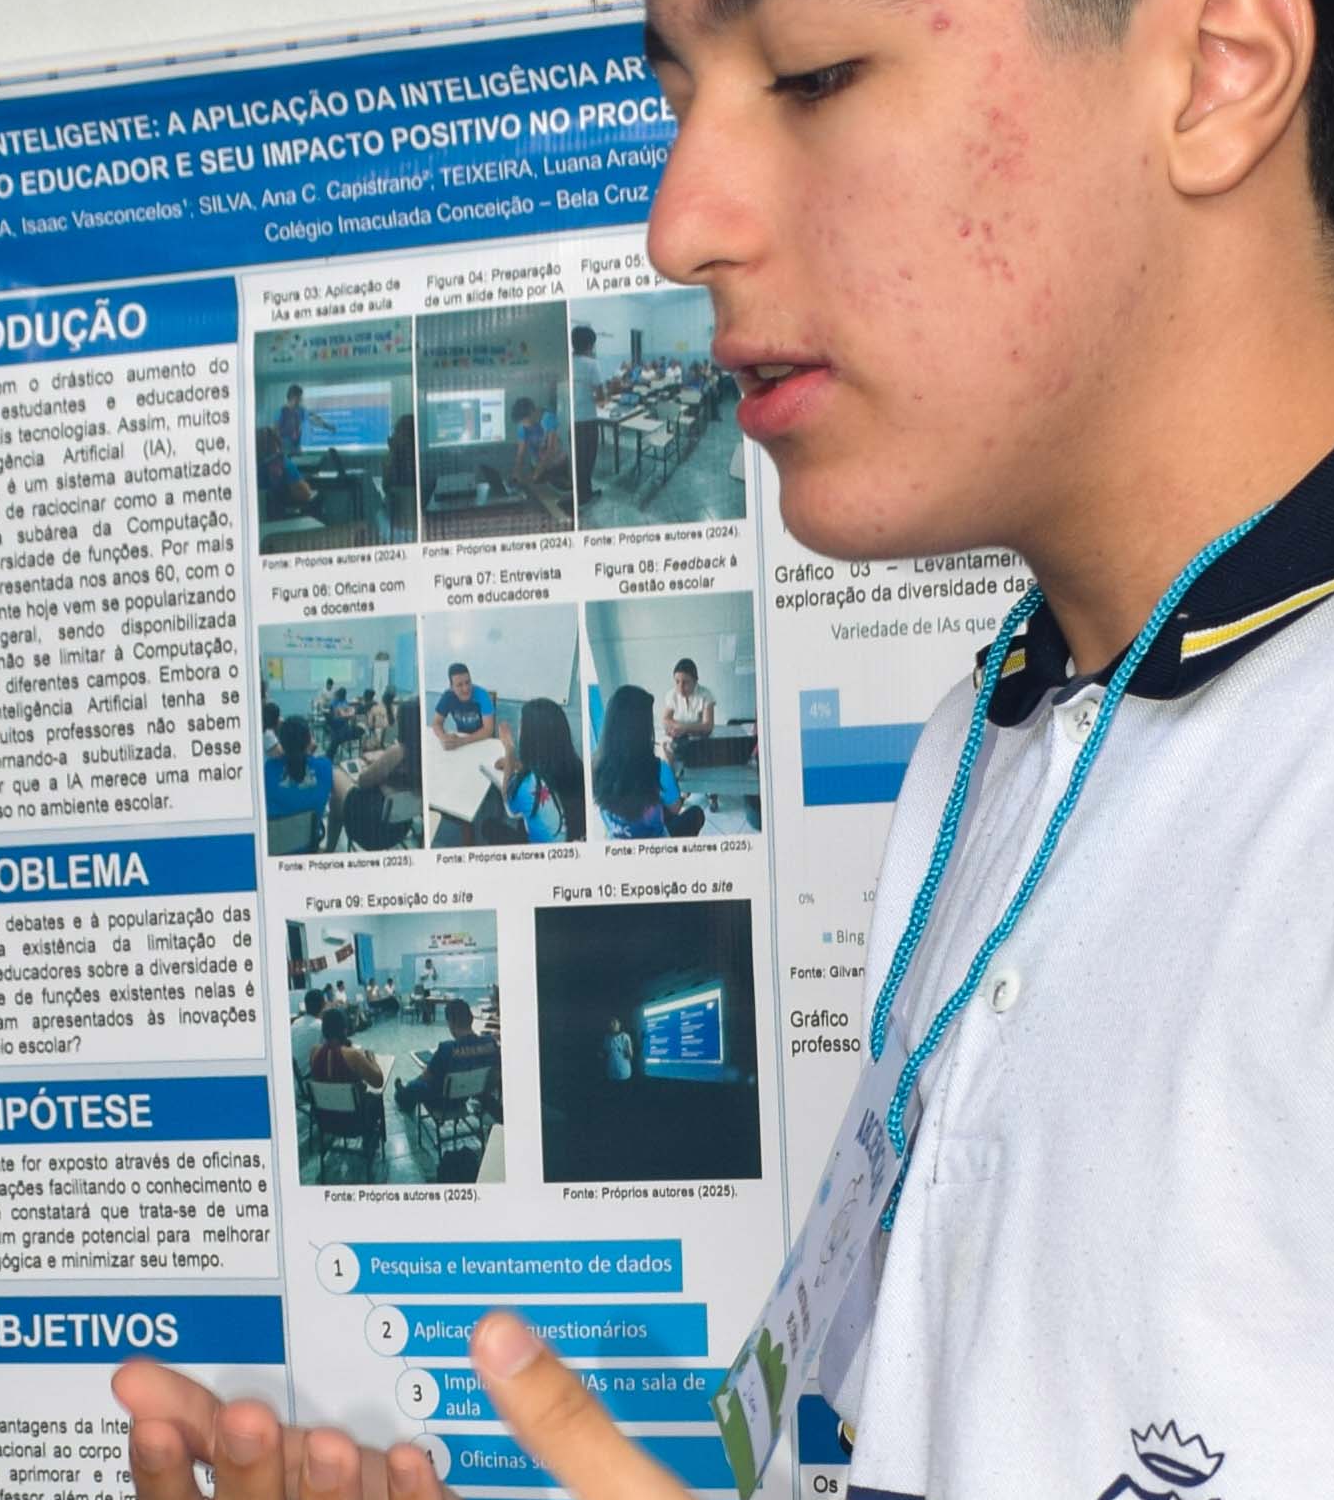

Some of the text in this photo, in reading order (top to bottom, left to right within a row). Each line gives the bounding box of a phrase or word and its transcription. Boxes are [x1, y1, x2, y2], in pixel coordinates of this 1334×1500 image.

[167, 111, 187, 136] A
[191, 90, 349, 133] APLICAÇÃO
[354, 86, 397, 114] DA
[400, 62, 599, 108] INTELIGÊNCIA
[604, 56, 647, 85] AR
[20, 155, 170, 197] EDUCADOR
[175, 152, 194, 178] E
[200, 145, 255, 175] SEU
[262, 130, 385, 168] IMPACTO
[391, 113, 522, 153] POSITIVO
[529, 107, 571, 140] NO
[21, 215, 68, 235] Isaac
[198, 191, 257, 215] SILVA,
[261, 188, 297, 208] Ana
[543, 154, 603, 176] Luana
[264, 219, 334, 243] Colégio
[337, 206, 432, 234] Imaculada
[436, 195, 535, 224] Conceição
[556, 187, 600, 210] Bela
[604, 183, 649, 205] Cruz
[775, 564, 835, 585] Gráfico
[850, 562, 871, 578] 03
[775, 585, 866, 613] exploração
[871, 584, 892, 603] da
[897, 576, 998, 601] diversidade
[830, 619, 909, 641] Variedade
[912, 616, 933, 635] de
[965, 617, 996, 635] que
[552, 880, 733, 902] Figura 10: Exposição do site
[862, 891, 875, 902] 10
[305, 891, 474, 913] Figura 09: Exposição do site
[837, 930, 865, 947] Bing
[790, 1009, 849, 1029] Gráfico
[791, 1035, 861, 1057] professo
[334, 1261, 344, 1277] 1
[370, 1253, 673, 1278] Pesquisa e levantamento de dados
[382, 1322, 392, 1339] 2
[414, 1322, 475, 1343] Aplicaç
[613, 1377, 636, 1391] na
[641, 1373, 677, 1391] sala
[682, 1373, 706, 1391] de
[413, 1385, 423, 1402] 3
[446, 1399, 481, 1417] aula
[459, 1450, 527, 1469] Oficinas
[813, 1476, 838, 1495] Os
